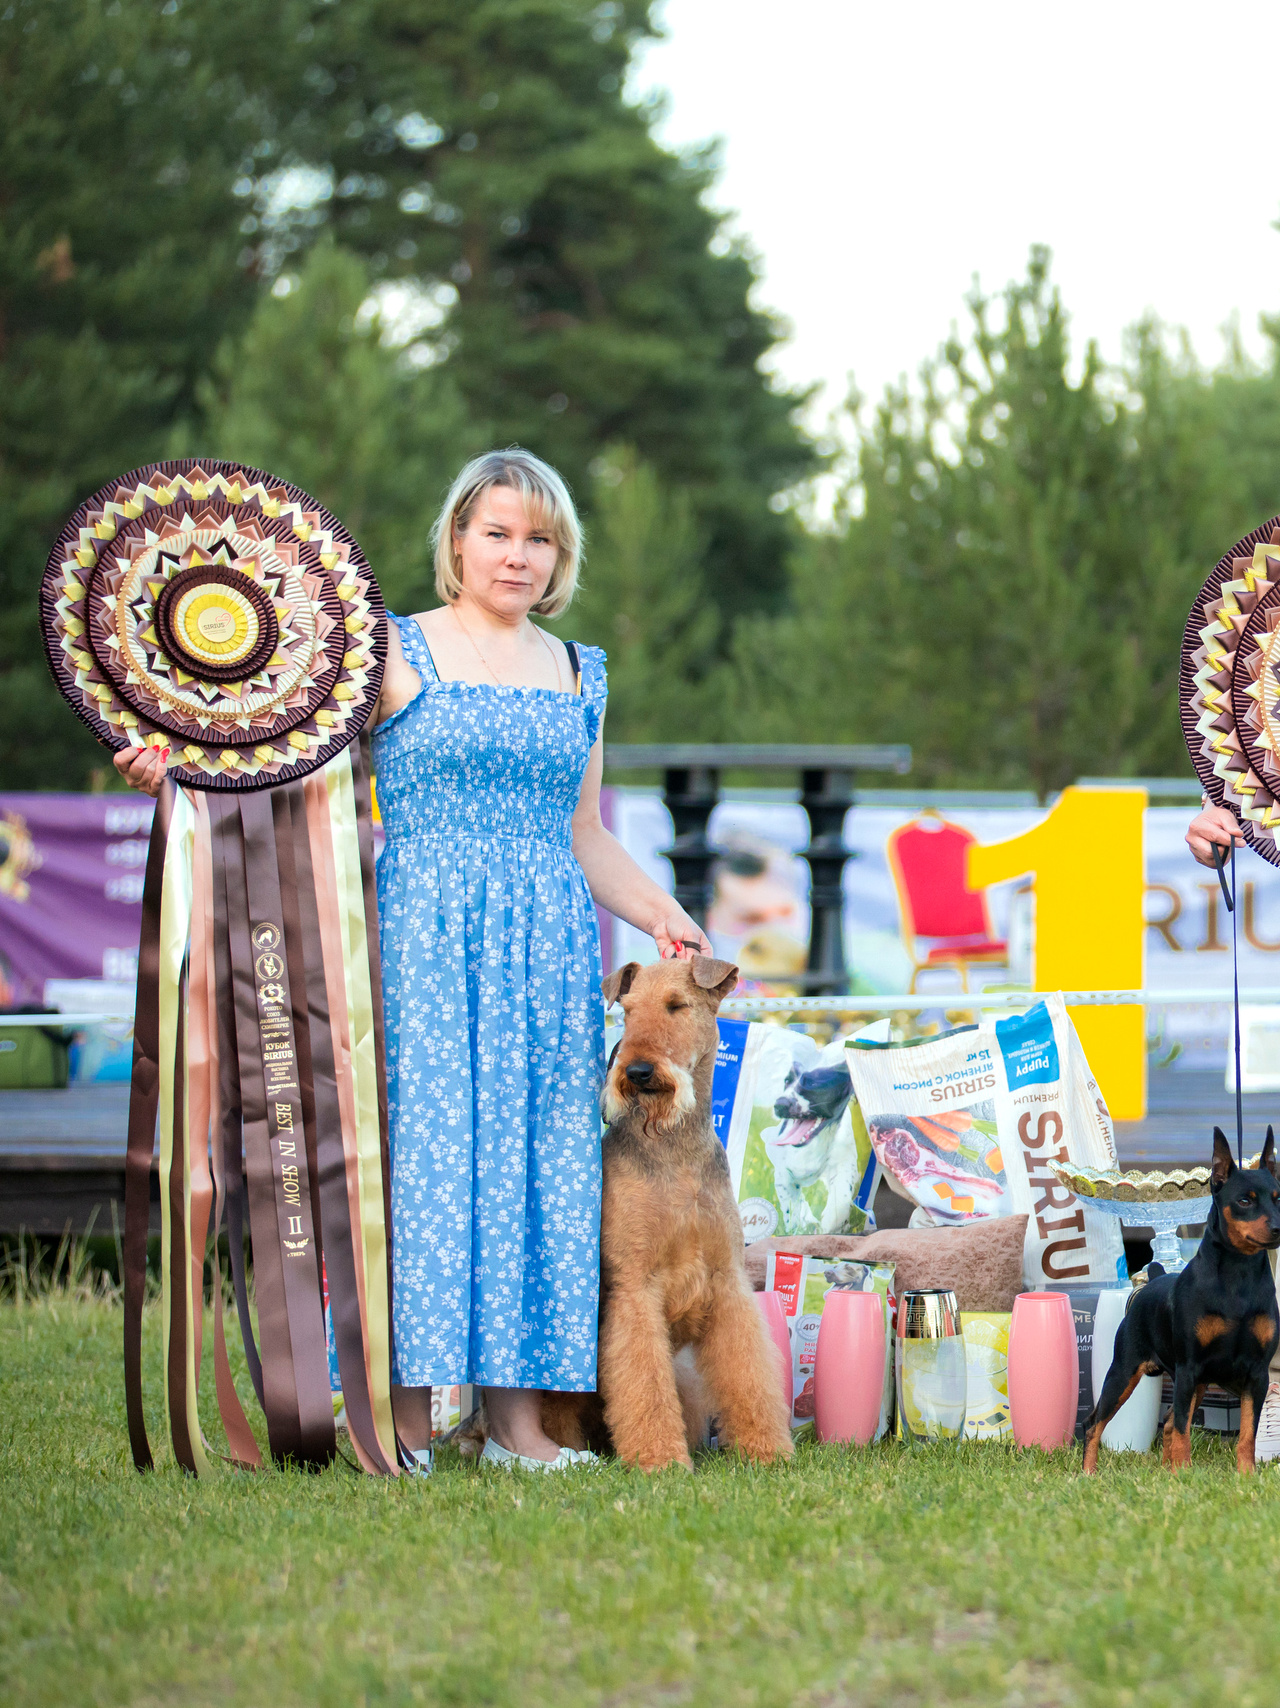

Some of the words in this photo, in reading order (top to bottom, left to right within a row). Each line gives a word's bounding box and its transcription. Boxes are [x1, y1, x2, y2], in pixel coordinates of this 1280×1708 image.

[203, 622, 226, 631] SIRIUS
[265, 1041, 291, 1051] КУБОК
[263, 1050, 294, 1060] SIRIUS
[717, 1052, 739, 1063] MIUM
[978, 1049, 992, 1061] 15
[944, 1062, 994, 1083] ЯГНЕНОК
[1016, 1055, 1050, 1077] PUPPY
[893, 1078, 933, 1091] РИСОМ
[930, 1074, 996, 1103] SIRIUS
[1013, 1092, 1059, 1106] PREMIUM
[275, 1101, 295, 1134] BEST
[713, 1114, 725, 1127] LT
[278, 1139, 297, 1159] IN
[281, 1163, 301, 1208] SHOW
